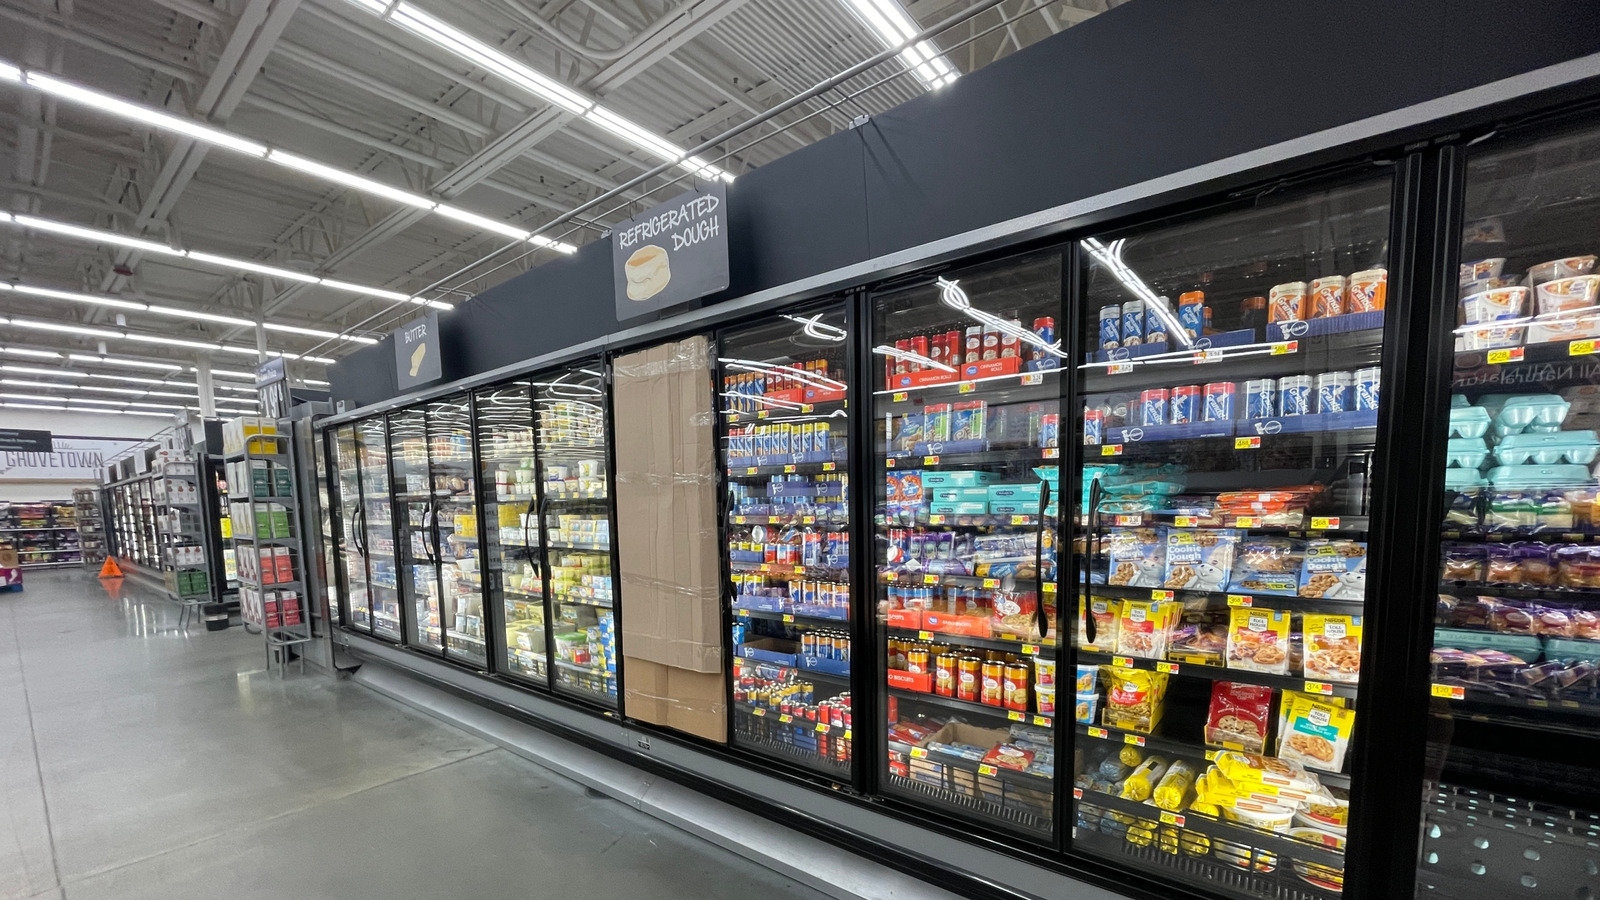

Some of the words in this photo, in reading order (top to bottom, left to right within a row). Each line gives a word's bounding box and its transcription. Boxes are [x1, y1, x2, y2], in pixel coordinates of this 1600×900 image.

[619, 193, 719, 250] REFRIGERATED
[671, 215, 719, 251] DOUGH
[405, 324, 427, 344] BUTTER
[1573, 343, 1591, 352] 228
[1490, 352, 1507, 361] 228
[5, 451, 104, 468] GROVETOWN
[1170, 545, 1202, 553] Cookie
[1170, 552, 1202, 561] Dough
[1307, 562, 1347, 571] Dough
[1306, 682, 1320, 691] 374
